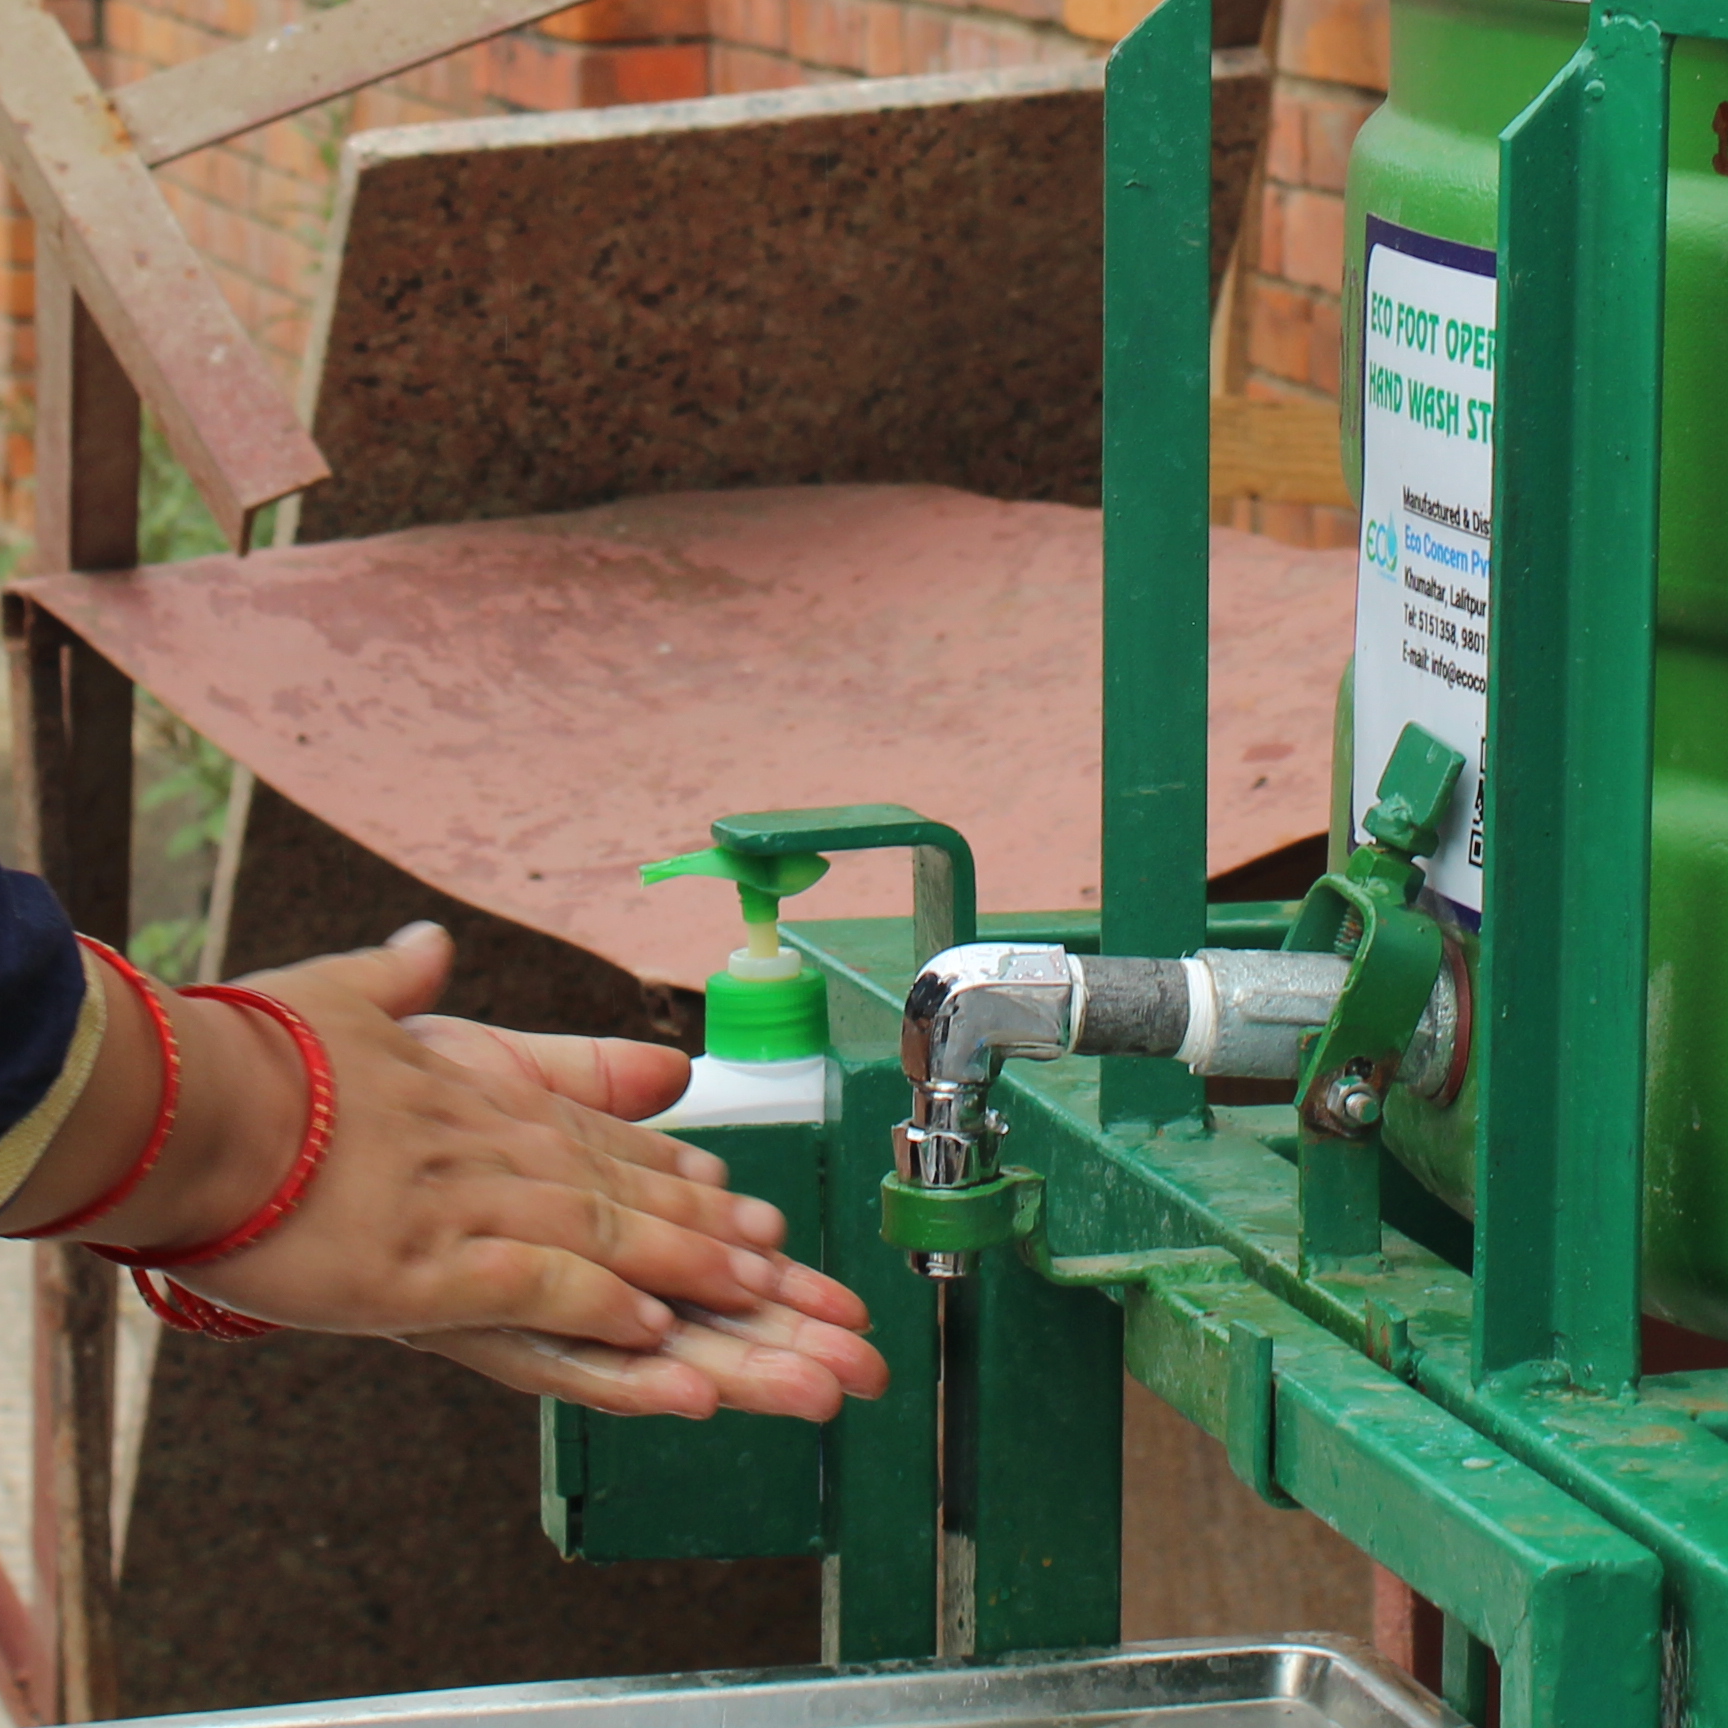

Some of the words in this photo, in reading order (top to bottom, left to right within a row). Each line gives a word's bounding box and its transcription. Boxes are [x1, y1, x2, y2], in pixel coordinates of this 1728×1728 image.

[1371, 290, 1394, 340] ECO
[1396, 301, 1440, 356] FOOT
[1368, 360, 1403, 415] HAND
[1408, 377, 1460, 439] WASH
[1402, 484, 1461, 527] Manufactured
[1463, 507, 1470, 529] &
[1405, 524, 1421, 555] Eco
[1424, 532, 1469, 573] Concern
[1450, 584, 1487, 620] Lalitpur
